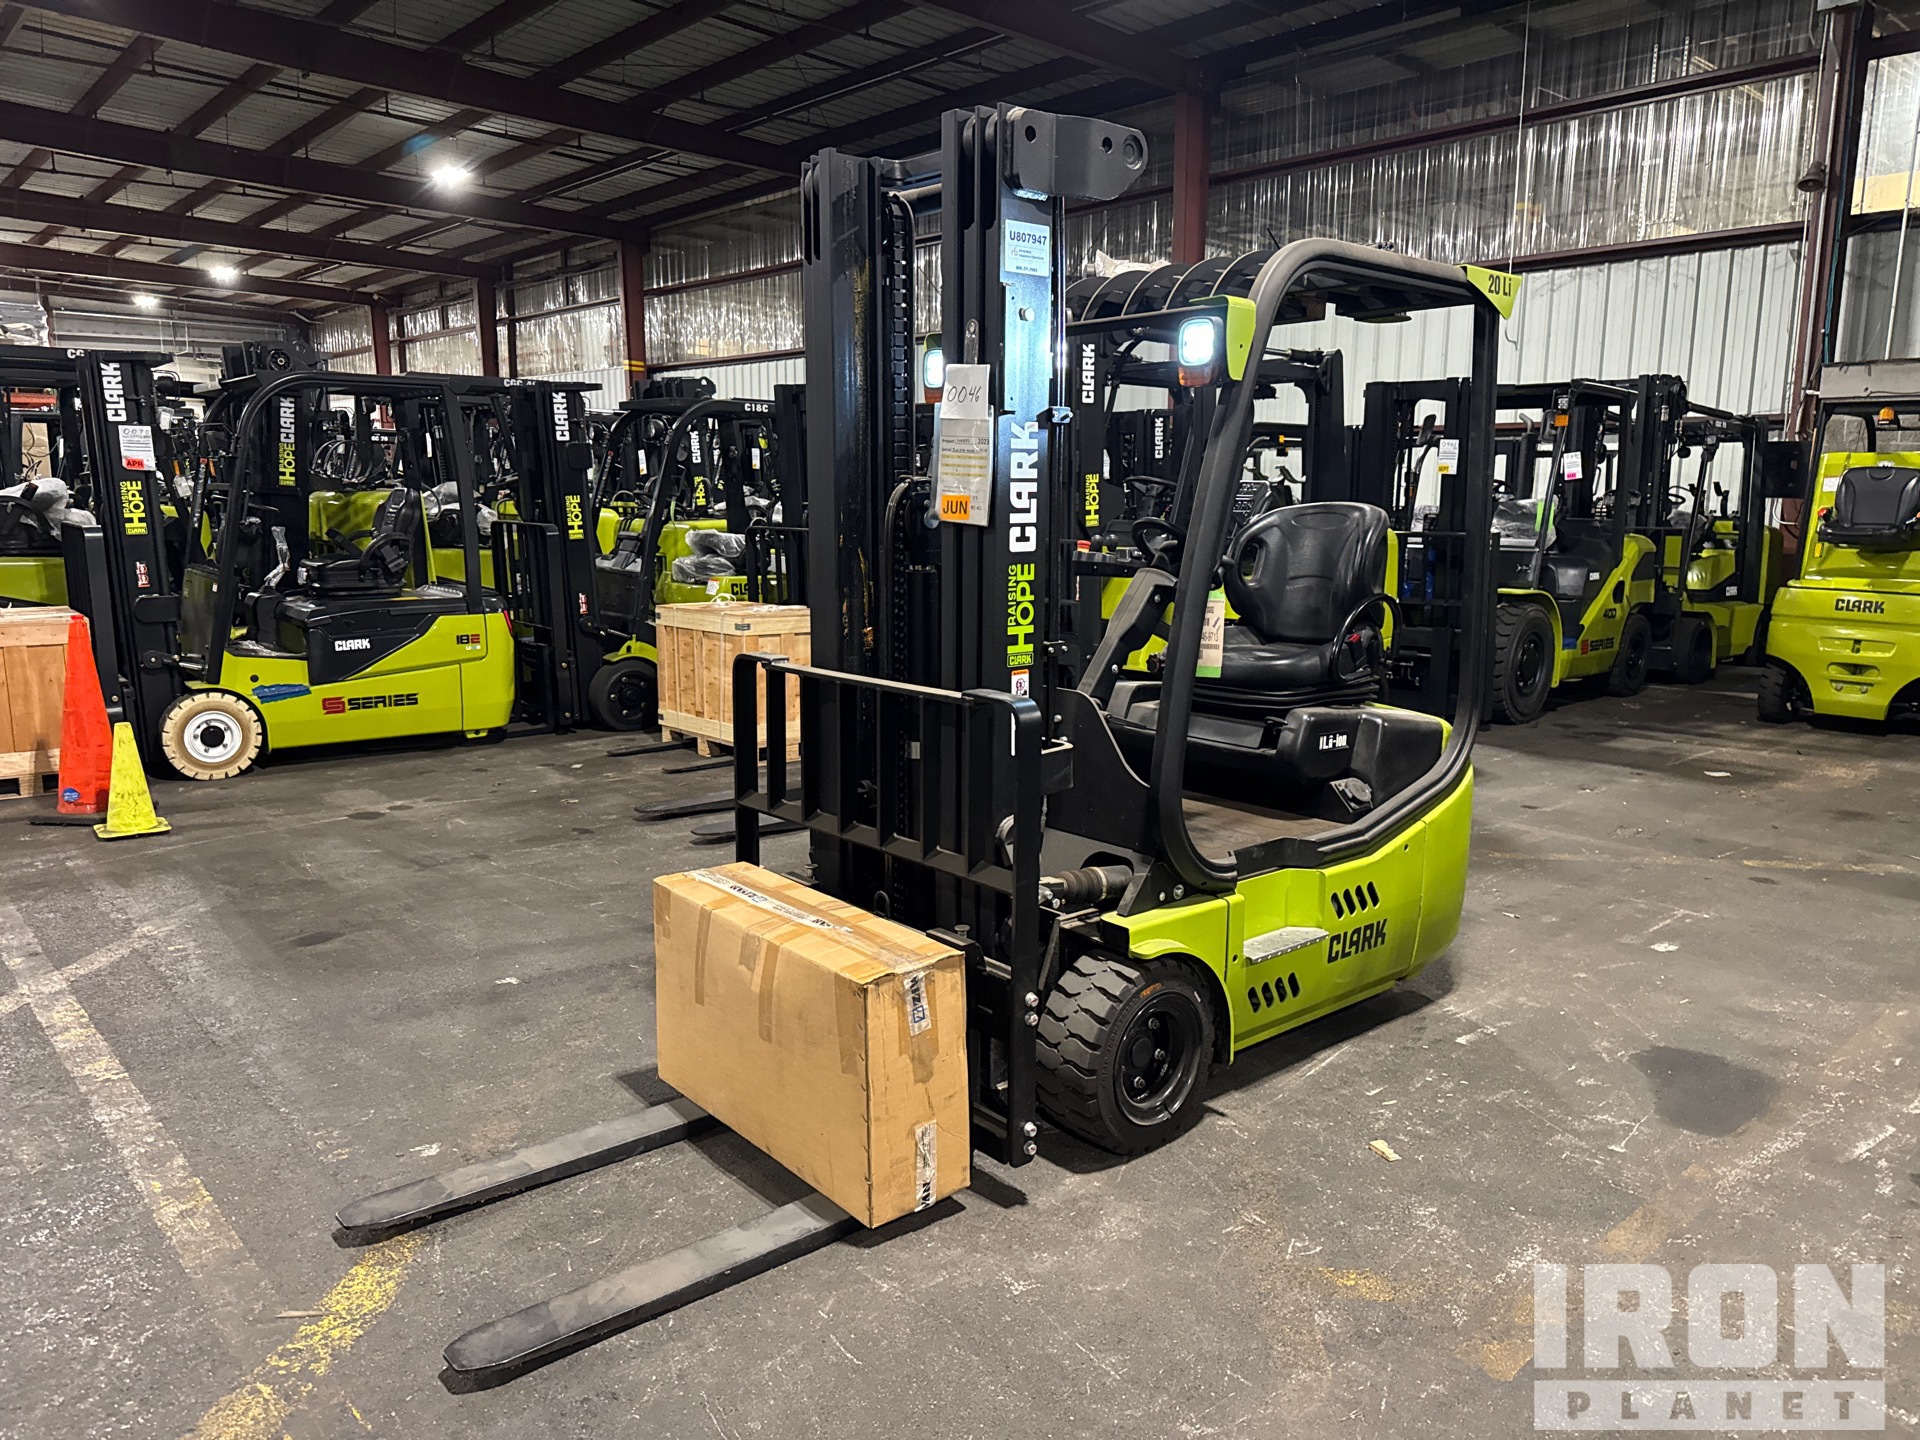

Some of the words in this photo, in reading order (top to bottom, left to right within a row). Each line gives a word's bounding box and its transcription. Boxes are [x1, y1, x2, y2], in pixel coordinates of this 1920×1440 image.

[1010, 231, 1047, 246] U807947
[1488, 274, 1500, 295] 20
[1503, 276, 1512, 297] Li
[1082, 344, 1095, 403] CLARK
[100, 363, 127, 422] CLARK
[745, 403, 769, 412] C18C
[947, 386, 981, 403] 0046
[281, 397, 295, 443] CLARK
[552, 392, 570, 441] CLARK
[690, 431, 702, 463] CLARK
[1155, 417, 1164, 459] CLARK
[126, 460, 144, 468] APR
[279, 443, 296, 480] HOPE
[120, 481, 130, 513] RAISING
[1009, 422, 1039, 553] CLARK
[1086, 473, 1100, 520] HOPE
[124, 481, 147, 528] HOPE
[565, 496, 573, 522] RAISING
[568, 495, 583, 534] HOPE
[943, 500, 968, 515] JUN
[1007, 564, 1017, 626] RAISING
[1007, 564, 1035, 654] HOPE
[1835, 599, 1885, 613] CLARK
[335, 638, 371, 651] CLARK
[456, 634, 480, 645] 18E
[1009, 655, 1032, 666] CLARK
[322, 696, 346, 715] S
[347, 693, 419, 710] SERIES
[1327, 918, 1388, 964] CLARK
